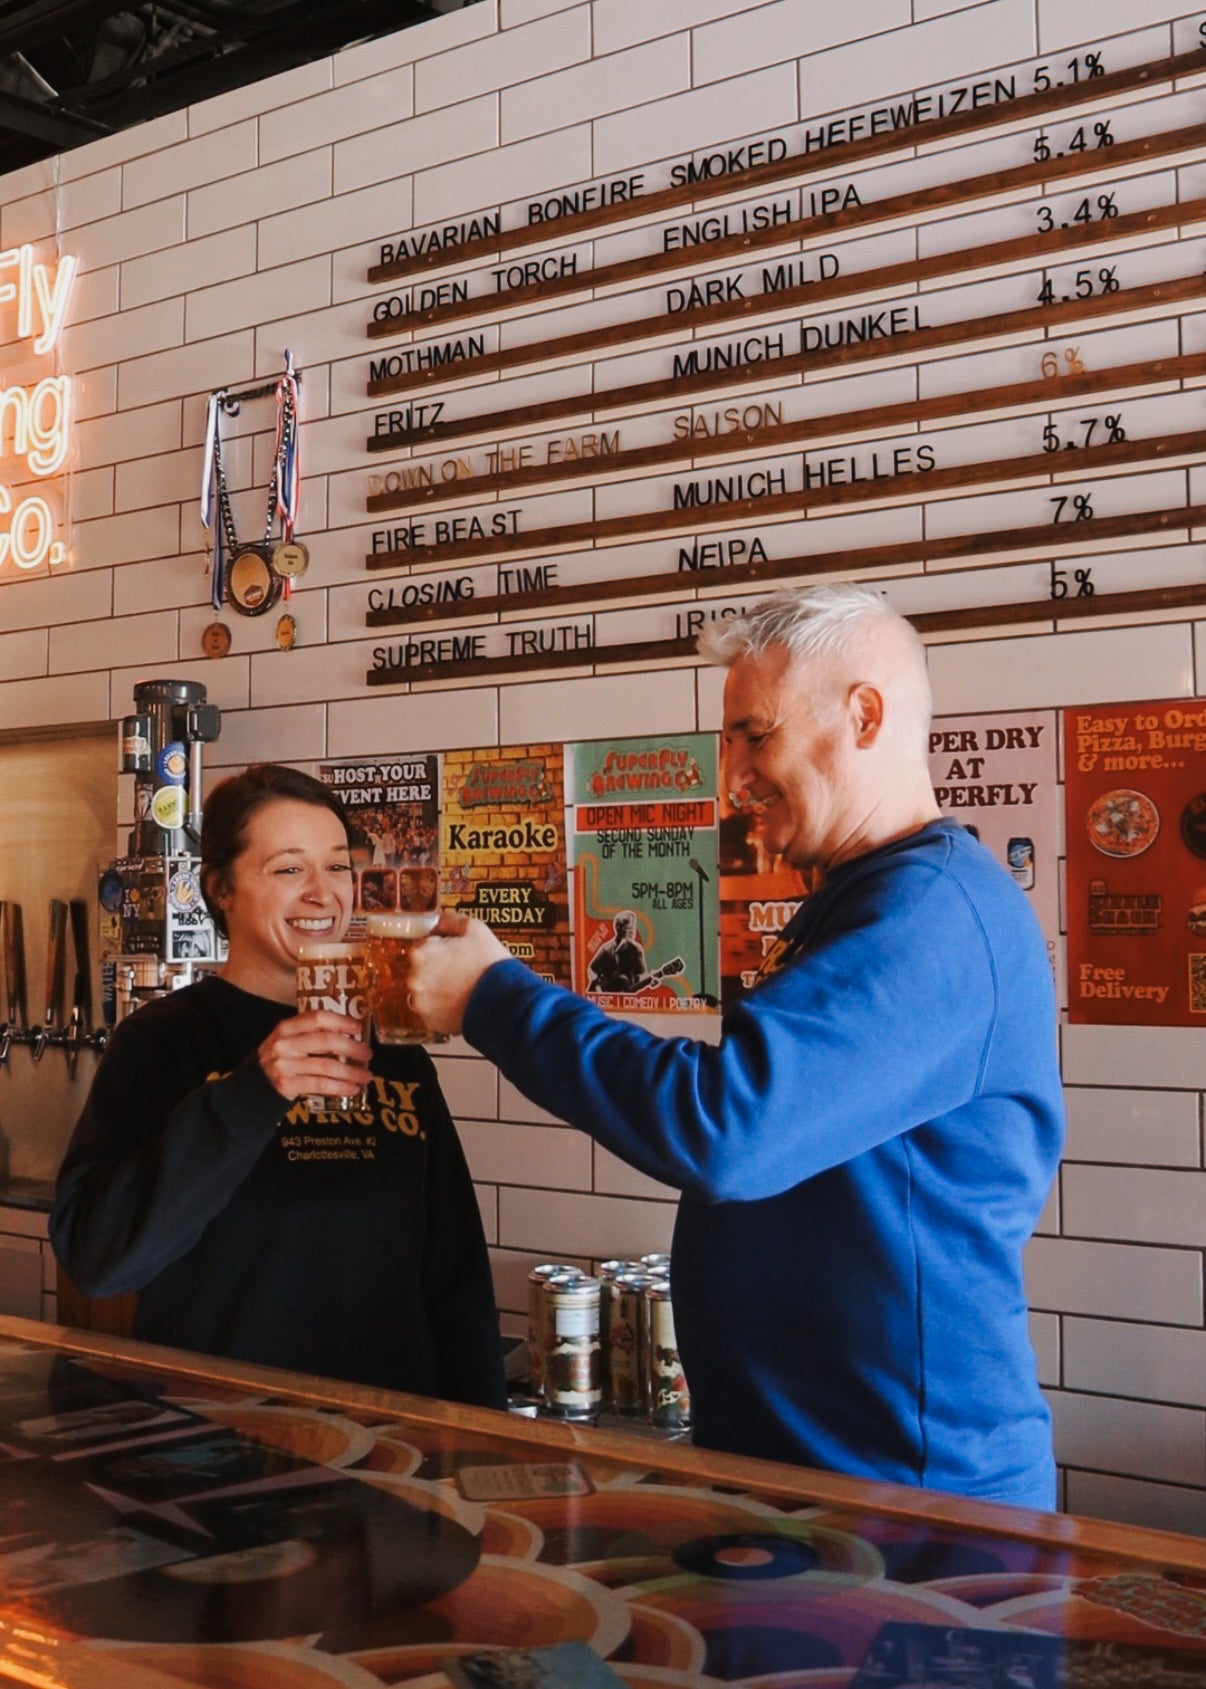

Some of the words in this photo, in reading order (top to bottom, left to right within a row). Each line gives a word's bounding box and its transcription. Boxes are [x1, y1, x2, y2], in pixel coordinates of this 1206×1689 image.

[1033, 120, 1114, 163] 5.4%
[381, 213, 500, 266] BAVARIAN
[528, 175, 645, 226] BONFIRE
[670, 138, 787, 189] SMOKED
[805, 75, 1016, 153] HEFEWEIZEN
[1033, 51, 1105, 93] 5.1%
[662, 199, 791, 252] ENGLISH
[810, 183, 862, 217] IPA
[1037, 192, 1119, 234] 3.4%
[373, 280, 468, 323] GOLDEN
[492, 253, 577, 293] TORCH
[667, 274, 744, 315] DARK
[763, 253, 840, 294] MILD
[1037, 265, 1120, 304] 4.5%
[673, 333, 784, 379] MUNICH
[802, 305, 931, 353] DUNKEL
[369, 334, 485, 382] MOTHMAN
[1041, 345, 1085, 379] 6%
[375, 402, 445, 436] FRITZ
[673, 401, 783, 442] SAISON
[1042, 413, 1128, 453] 5.7%
[367, 465, 434, 496] DOWN
[441, 455, 473, 481] ON
[485, 444, 535, 472] THE
[547, 430, 621, 462] FARM
[673, 469, 786, 510] MUNICH
[805, 445, 936, 489] HELLES
[1050, 493, 1094, 523] 7%
[372, 525, 425, 554] FIRE
[678, 537, 768, 573] NEIPA
[368, 576, 475, 612] CLOSING
[500, 564, 560, 594] TIME
[1052, 567, 1095, 600] 5%
[372, 635, 487, 670] SUPREME
[506, 624, 592, 655] TRUTH
[1076, 715, 1129, 736] Easy
[1135, 714, 1159, 730] to
[929, 731, 979, 753] PER
[985, 726, 1044, 750] DRY
[1077, 734, 1143, 754] Pizza,
[334, 767, 376, 784] HOST
[380, 763, 427, 780] YOUR
[945, 757, 985, 780] AT
[1078, 754, 1098, 772] &
[1103, 755, 1185, 771] more...
[334, 787, 383, 805] VENT
[386, 785, 432, 802] HERE
[934, 783, 1038, 808] PERFLY
[586, 806, 624, 826] OPEN
[630, 804, 656, 824] MIC
[662, 801, 705, 822] NIGHT
[449, 822, 556, 850] Karaoke
[597, 828, 642, 844] SECOND
[647, 826, 694, 842] SUNDAY
[601, 844, 616, 859] OF
[621, 843, 643, 859] THE
[648, 842, 690, 858] MONTH
[478, 888, 532, 903] EVERY
[631, 882, 693, 899] 5PM-8PM
[652, 899, 670, 910] ALL
[671, 898, 694, 910] AGES
[459, 907, 545, 923] THURSDAY
[1079, 963, 1125, 980] Free
[623, 996, 660, 1009] COMEDY
[1079, 981, 1169, 1003] Delivery
[304, 1136, 342, 1146] Preston
[362, 1150, 375, 1160] VA
